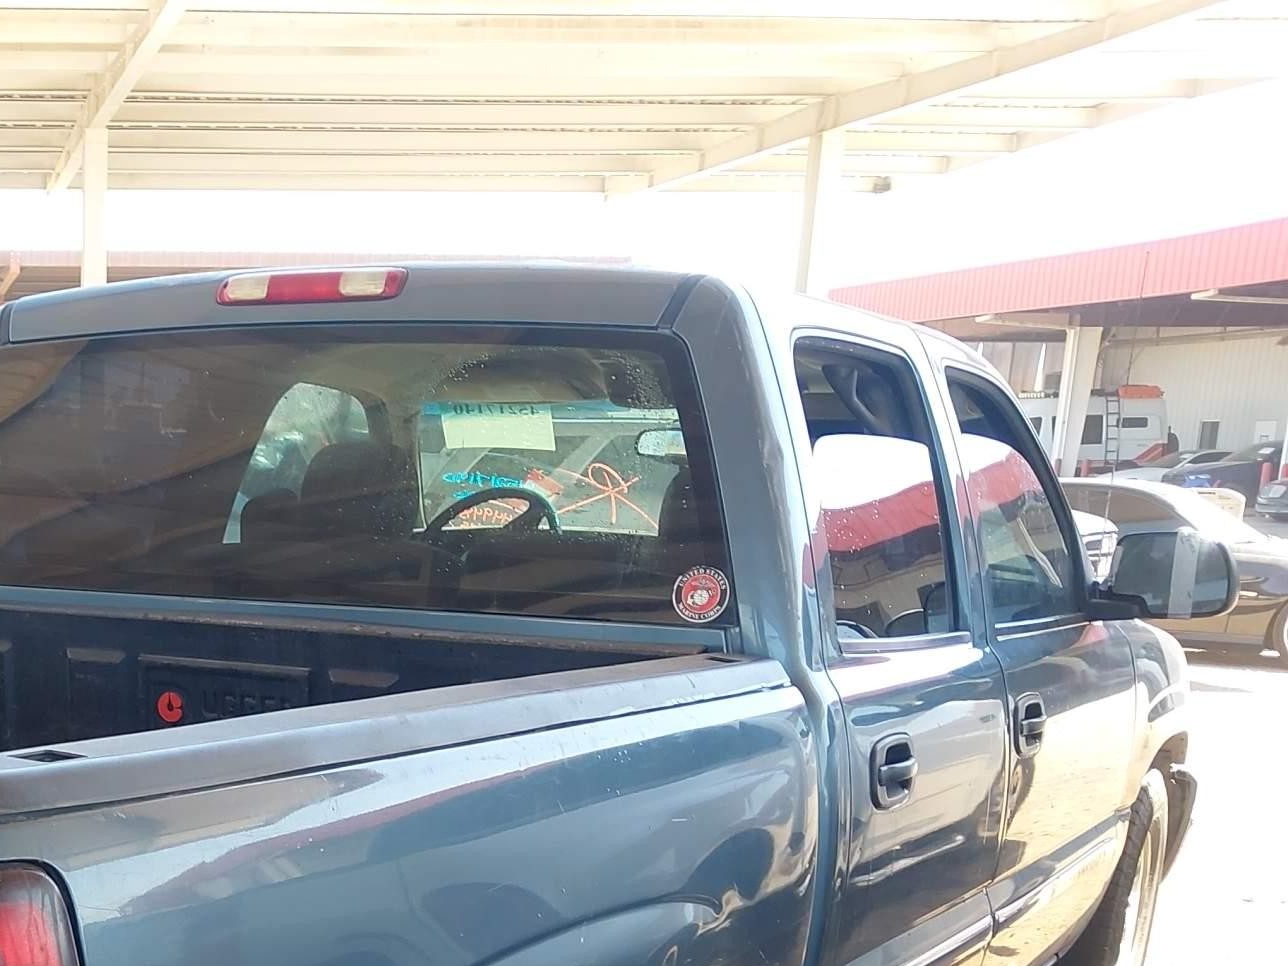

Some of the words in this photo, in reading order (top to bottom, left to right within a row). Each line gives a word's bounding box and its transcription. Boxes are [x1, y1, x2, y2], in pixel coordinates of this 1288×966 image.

[679, 569, 704, 587] UNITED
[705, 569, 726, 590] STATES
[678, 602, 700, 620] MARINE
[700, 605, 722, 620] CORPS
